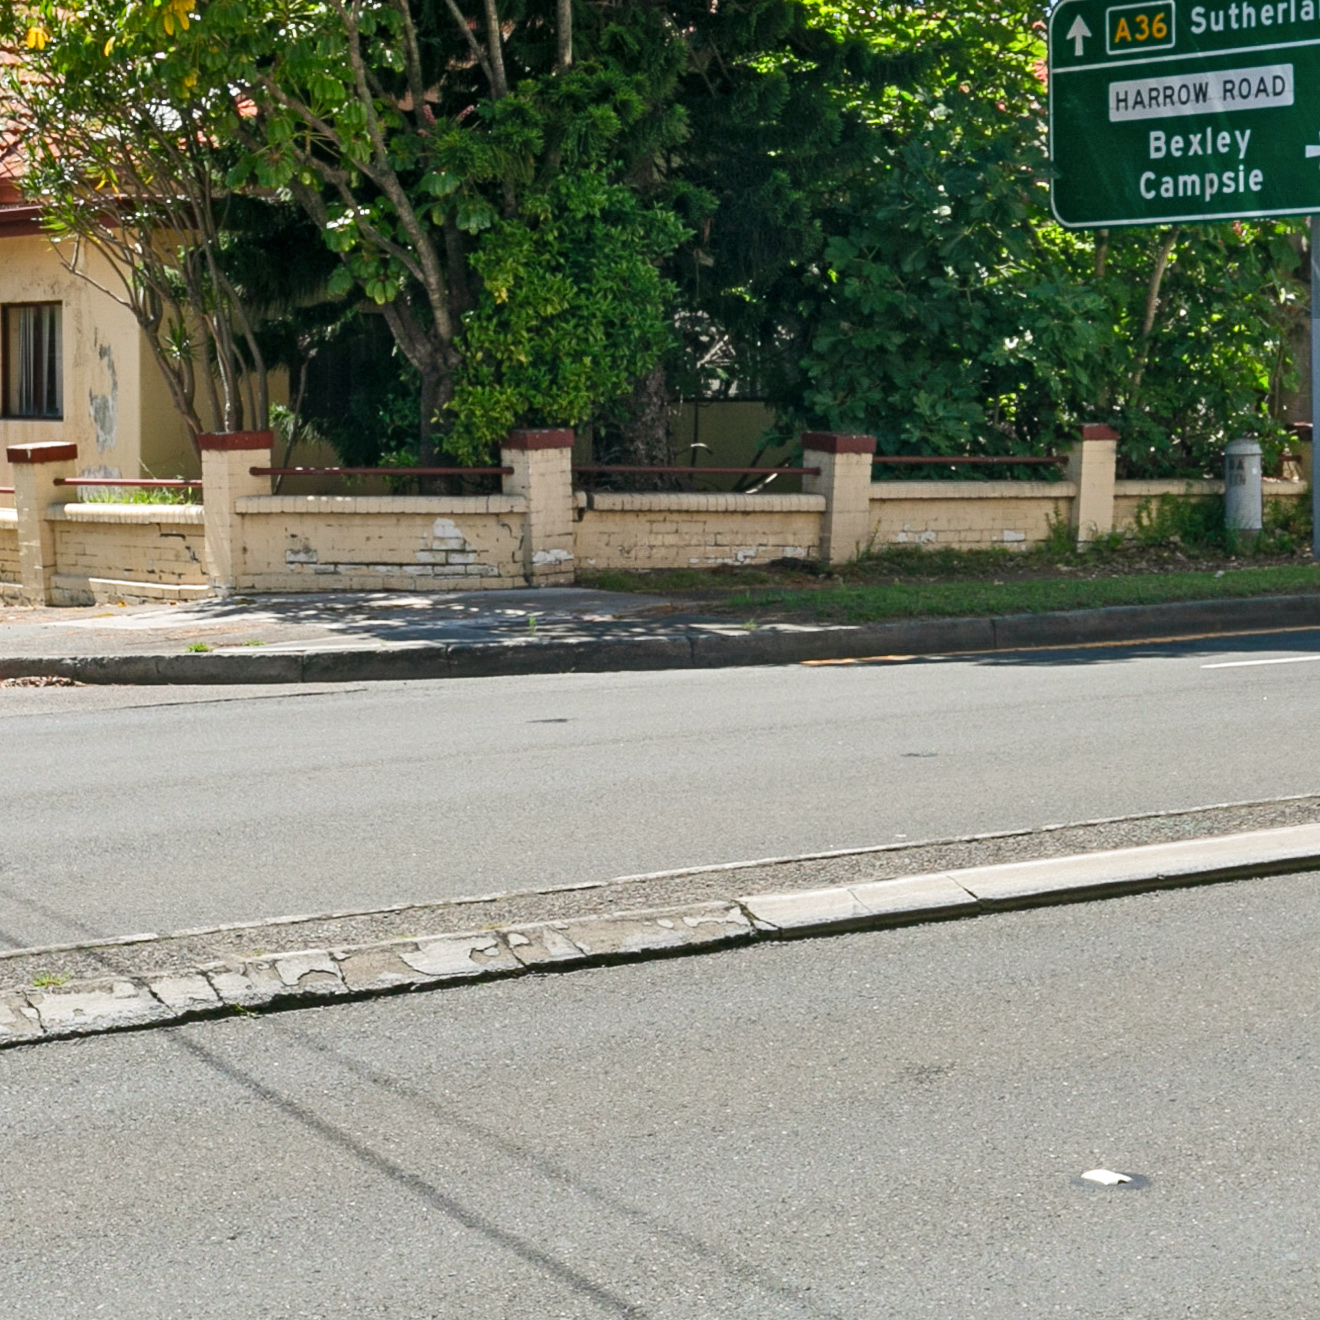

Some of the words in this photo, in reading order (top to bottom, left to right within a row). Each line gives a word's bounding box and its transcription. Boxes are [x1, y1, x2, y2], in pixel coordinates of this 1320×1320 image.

[1114, 12, 1168, 44] A36
[1115, 82, 1209, 112] HARROW
[1223, 75, 1286, 101] ROAD
[1149, 127, 1251, 159] Bexley
[1139, 164, 1264, 201] Campsie
